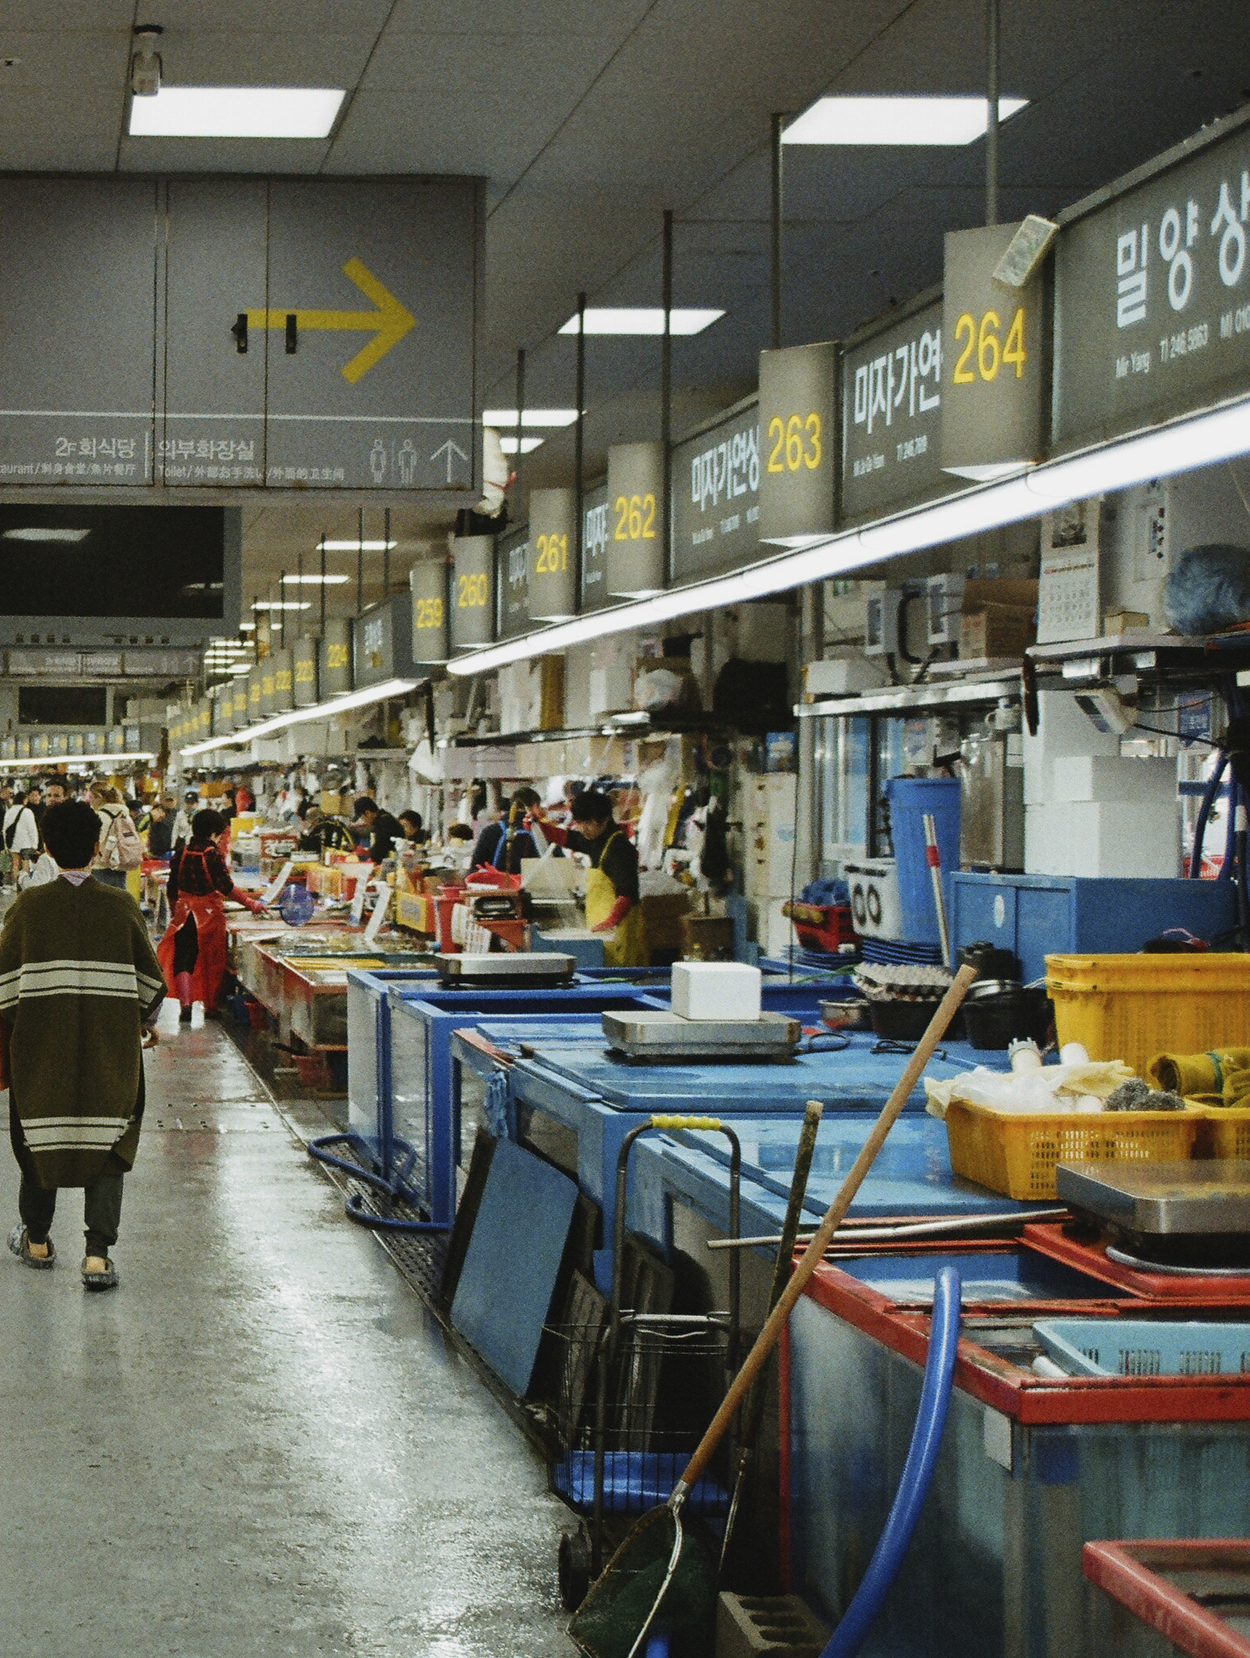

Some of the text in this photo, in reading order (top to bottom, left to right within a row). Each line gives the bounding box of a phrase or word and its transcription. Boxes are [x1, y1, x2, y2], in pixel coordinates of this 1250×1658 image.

[953, 307, 1026, 384] 264
[854, 329, 942, 434] 미자가연
[767, 412, 822, 473] 263
[615, 493, 656, 540] 262
[536, 533, 568, 573] 261
[416, 599, 443, 628] 259
[458, 573, 488, 608] 260
